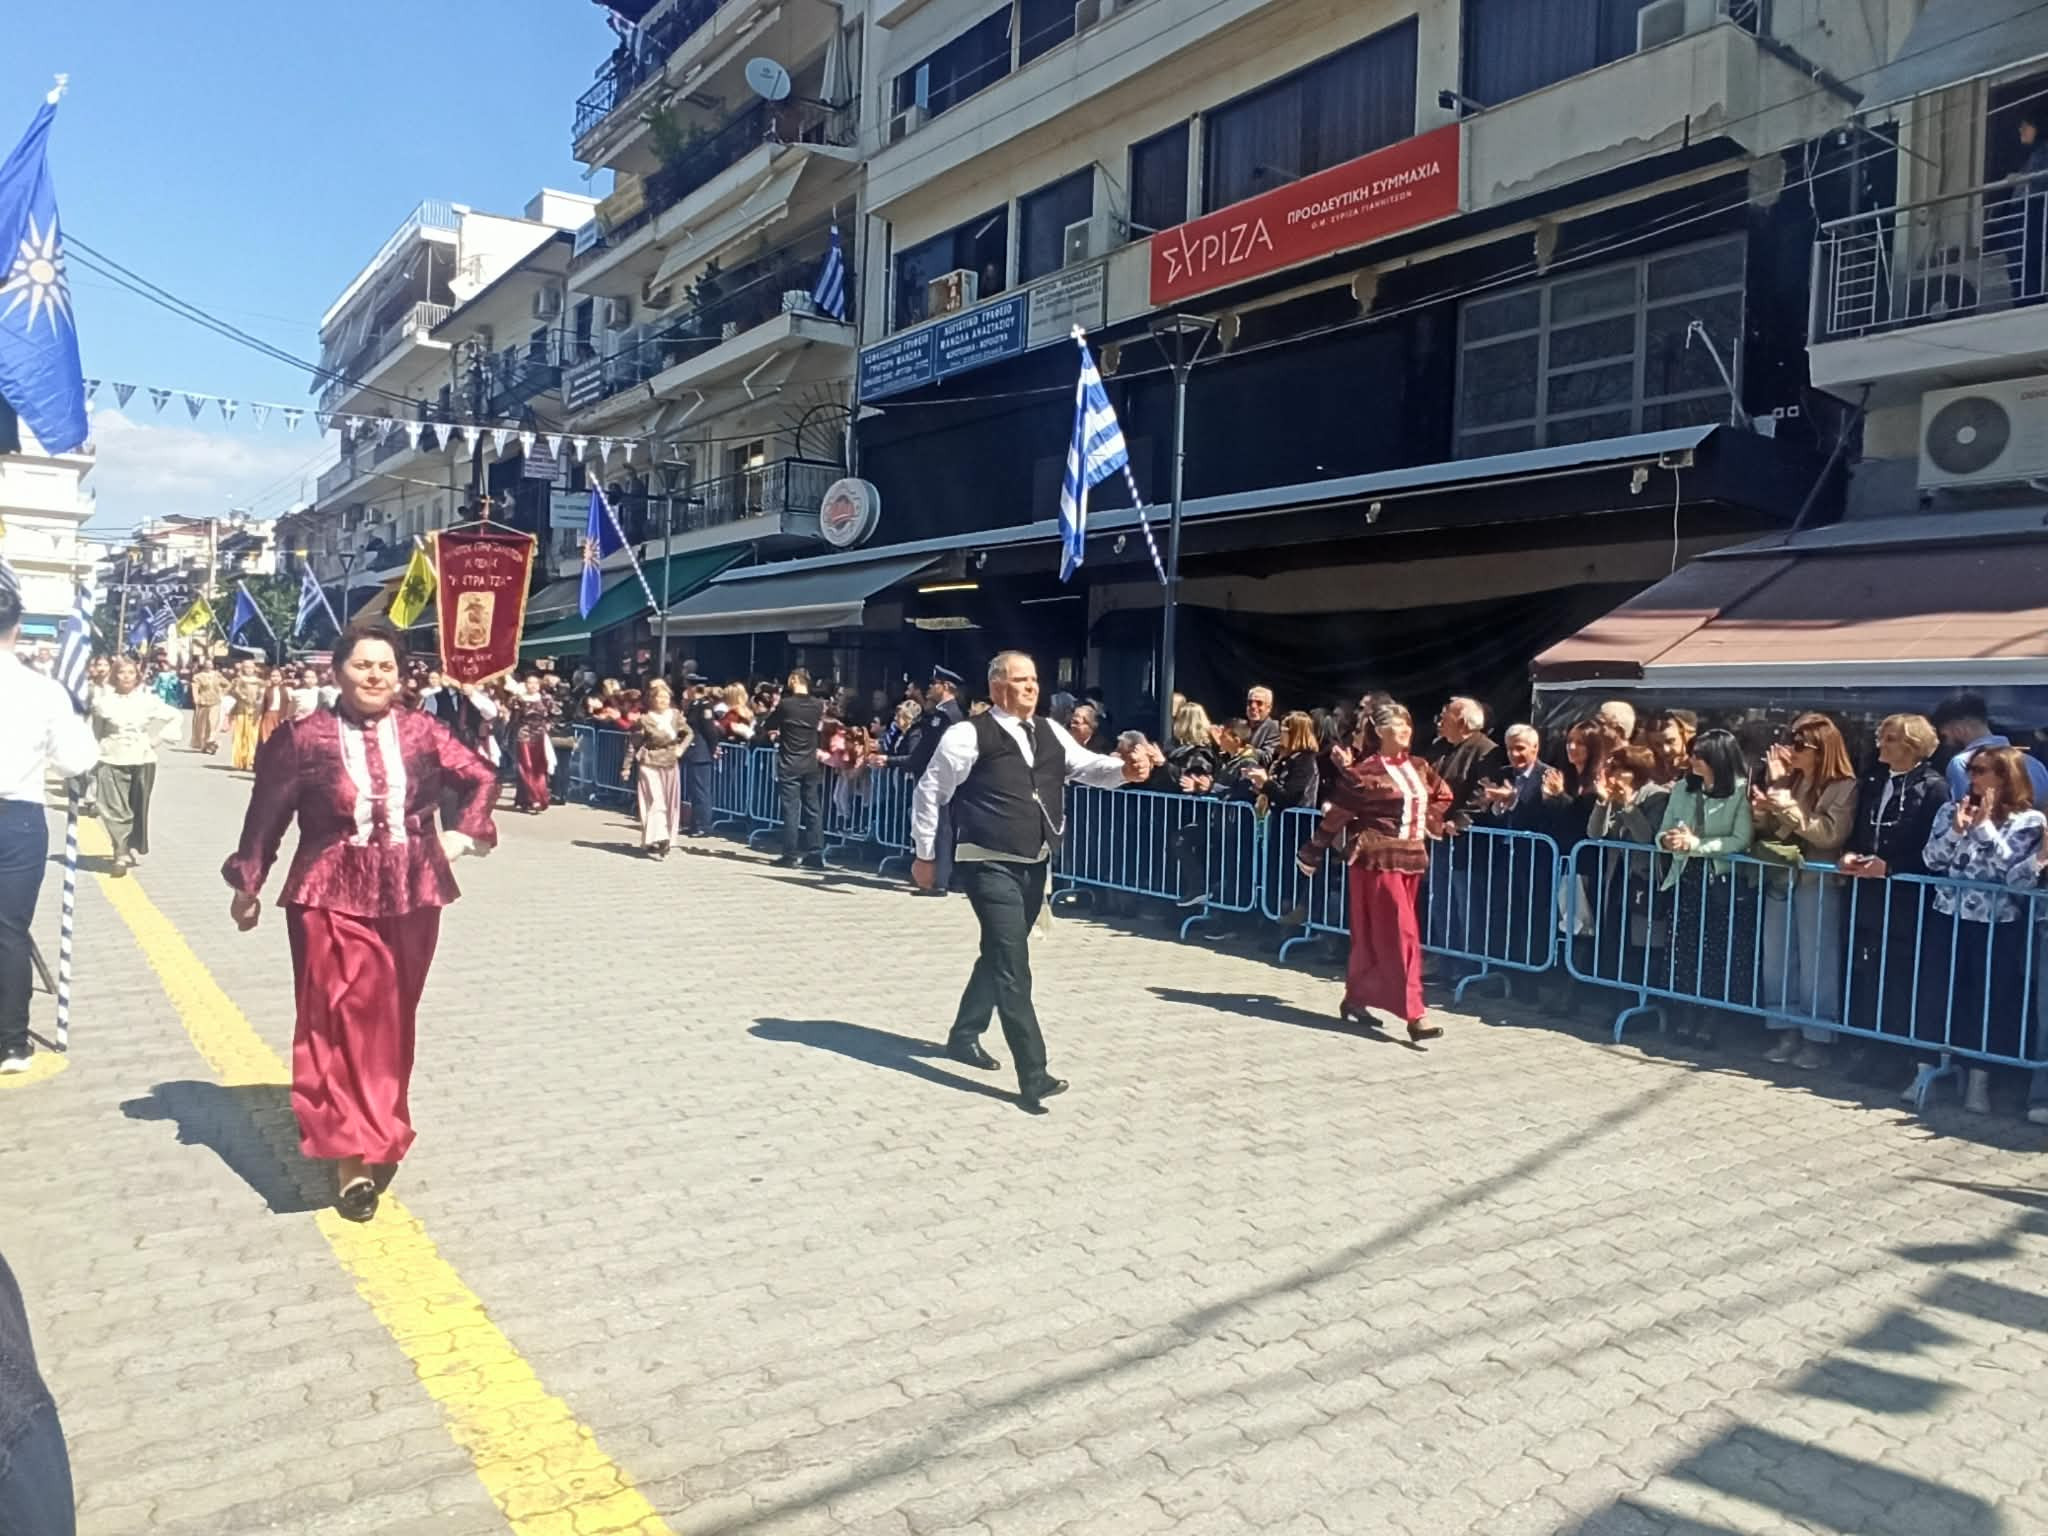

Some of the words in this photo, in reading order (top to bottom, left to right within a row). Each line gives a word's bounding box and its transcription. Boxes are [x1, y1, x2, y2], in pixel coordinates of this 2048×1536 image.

[1287, 186, 1368, 225] ΠΡΟΟΔΕΥΤΙΚΗ
[1372, 161, 1440, 195] ΣΥΜΜΑΧΙΑ
[1331, 208, 1359, 224] ΣΥΡΙΖΑ
[1162, 218, 1272, 284] ΣΥΡΙΖΑ
